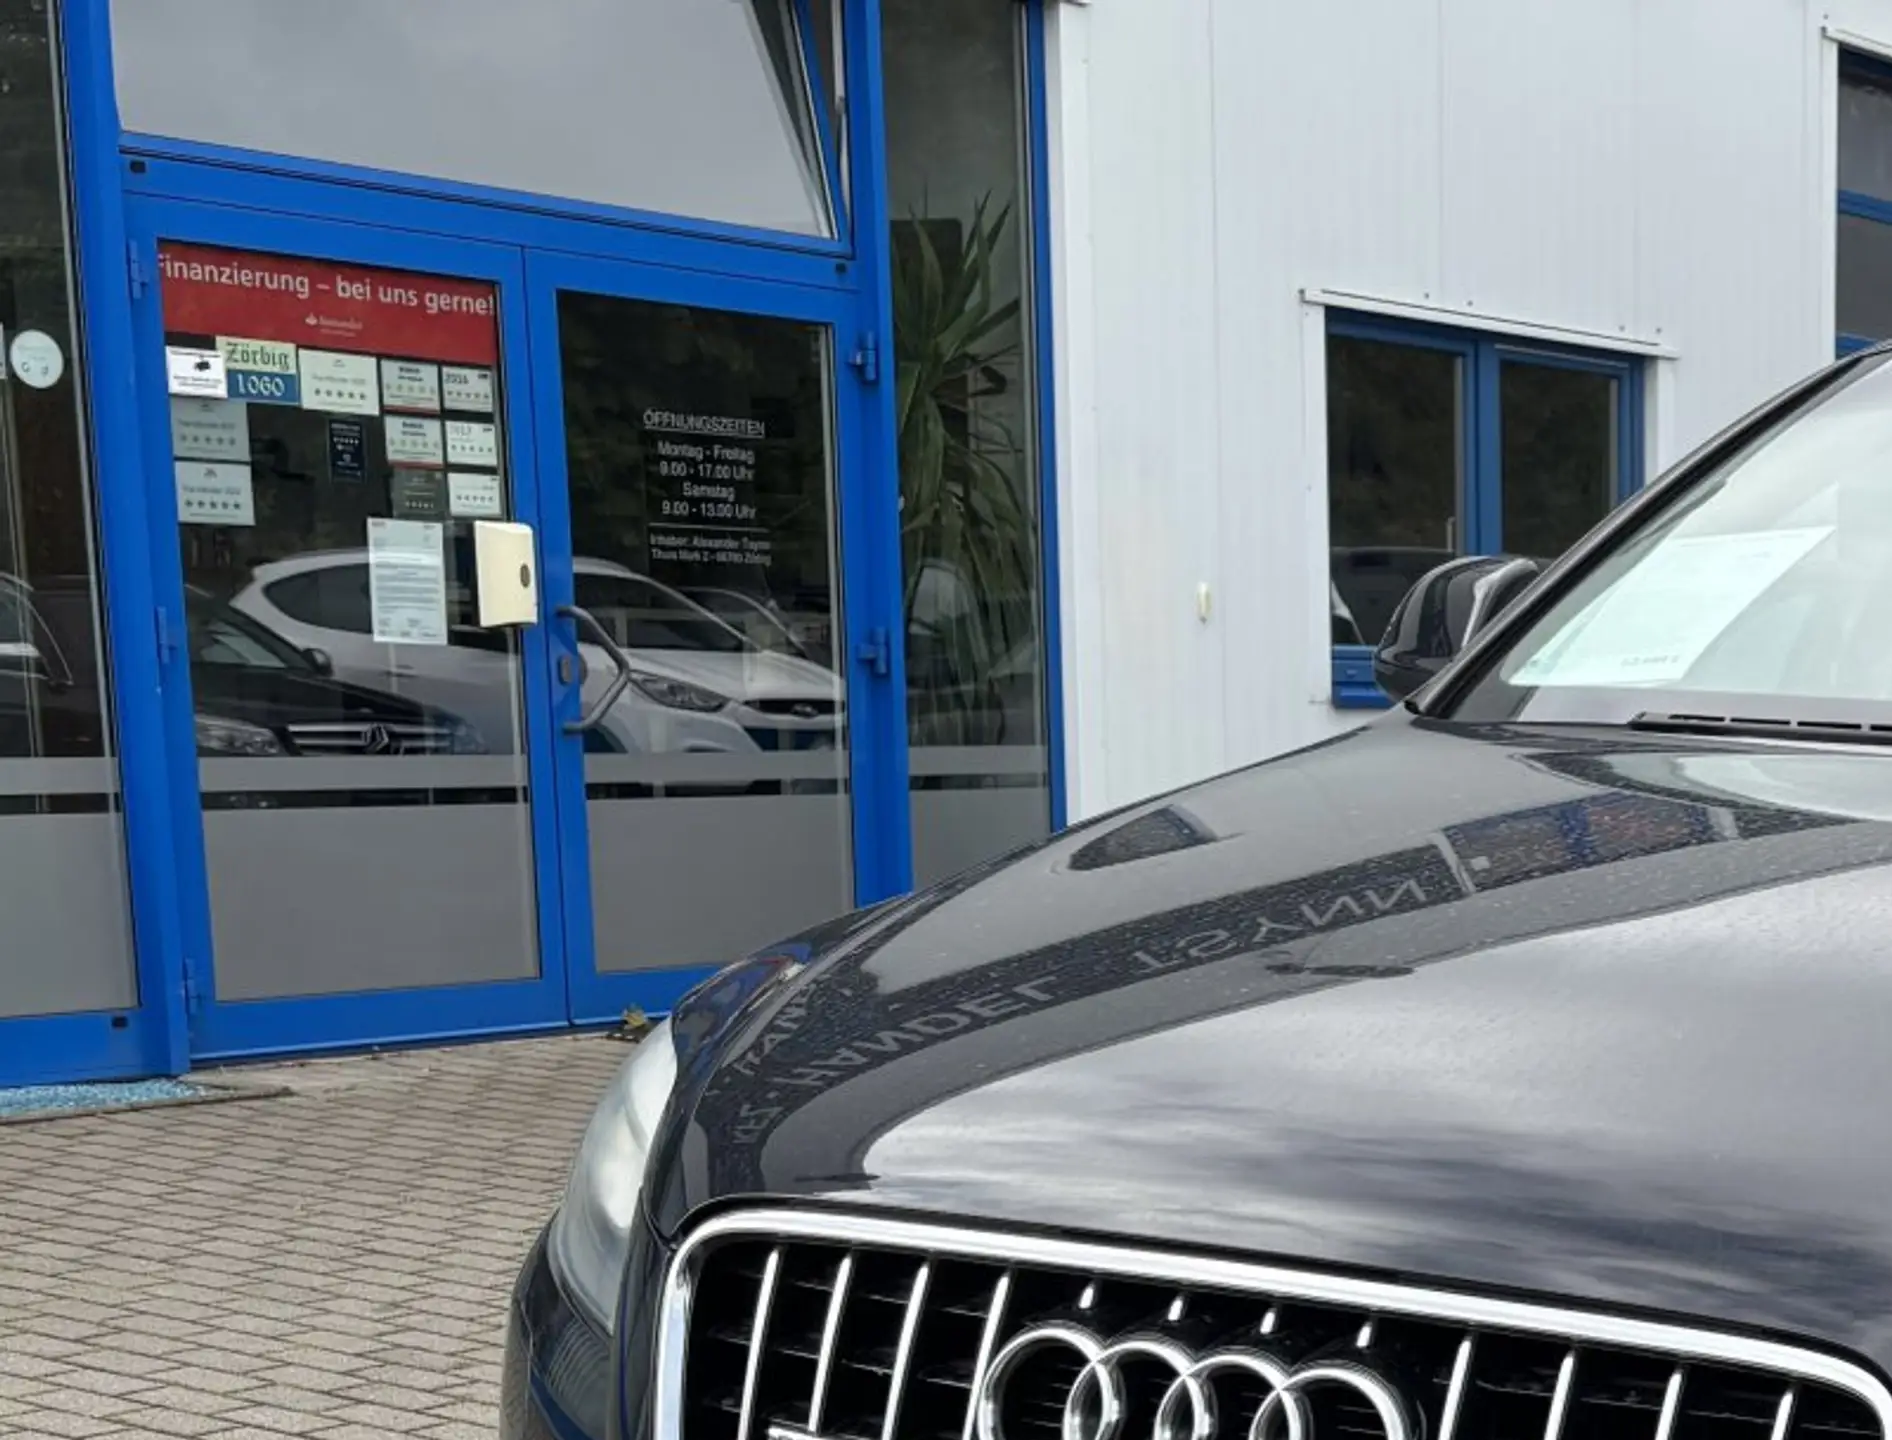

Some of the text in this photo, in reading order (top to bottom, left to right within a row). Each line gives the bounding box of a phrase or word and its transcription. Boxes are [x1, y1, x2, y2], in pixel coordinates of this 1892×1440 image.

[336, 274, 371, 302] bei
[378, 284, 418, 307] uns
[424, 290, 494, 316] gerne!
[643, 408, 765, 435] ÖFFNUNGSZEITEN
[658, 440, 704, 461] Montag
[713, 444, 755, 465] Freitag
[733, 465, 755, 481] Uhr
[682, 482, 736, 502] Samstag
[735, 503, 757, 519] Uhr
